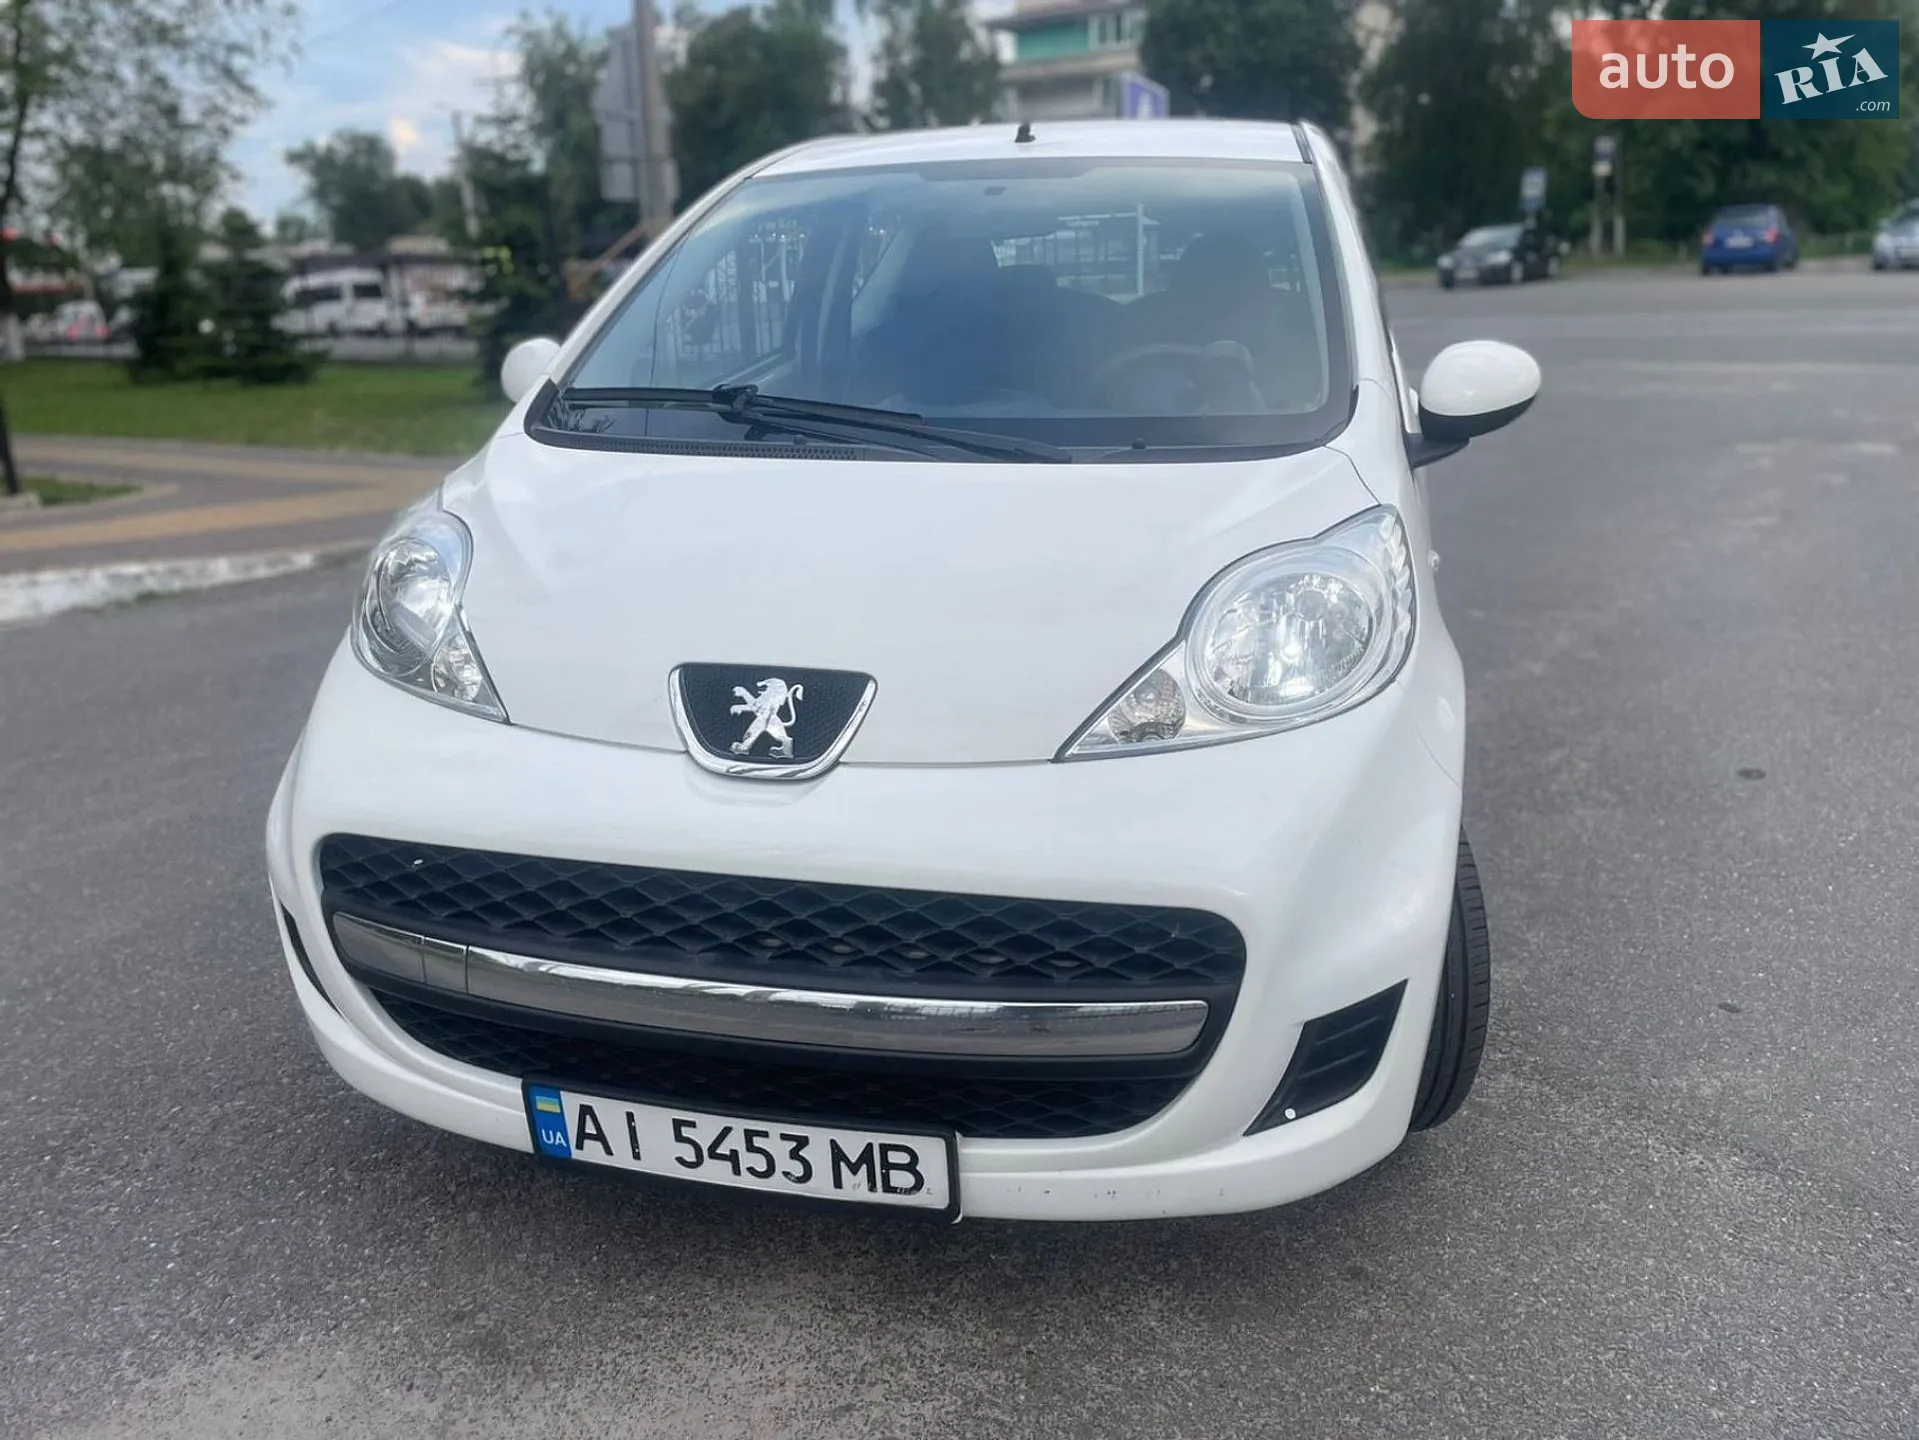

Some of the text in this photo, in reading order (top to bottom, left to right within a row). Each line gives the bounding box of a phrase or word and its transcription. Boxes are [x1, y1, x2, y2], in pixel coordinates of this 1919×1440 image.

[541, 1127, 568, 1148] UA
[575, 1103, 925, 1196] AI 5453 MB
